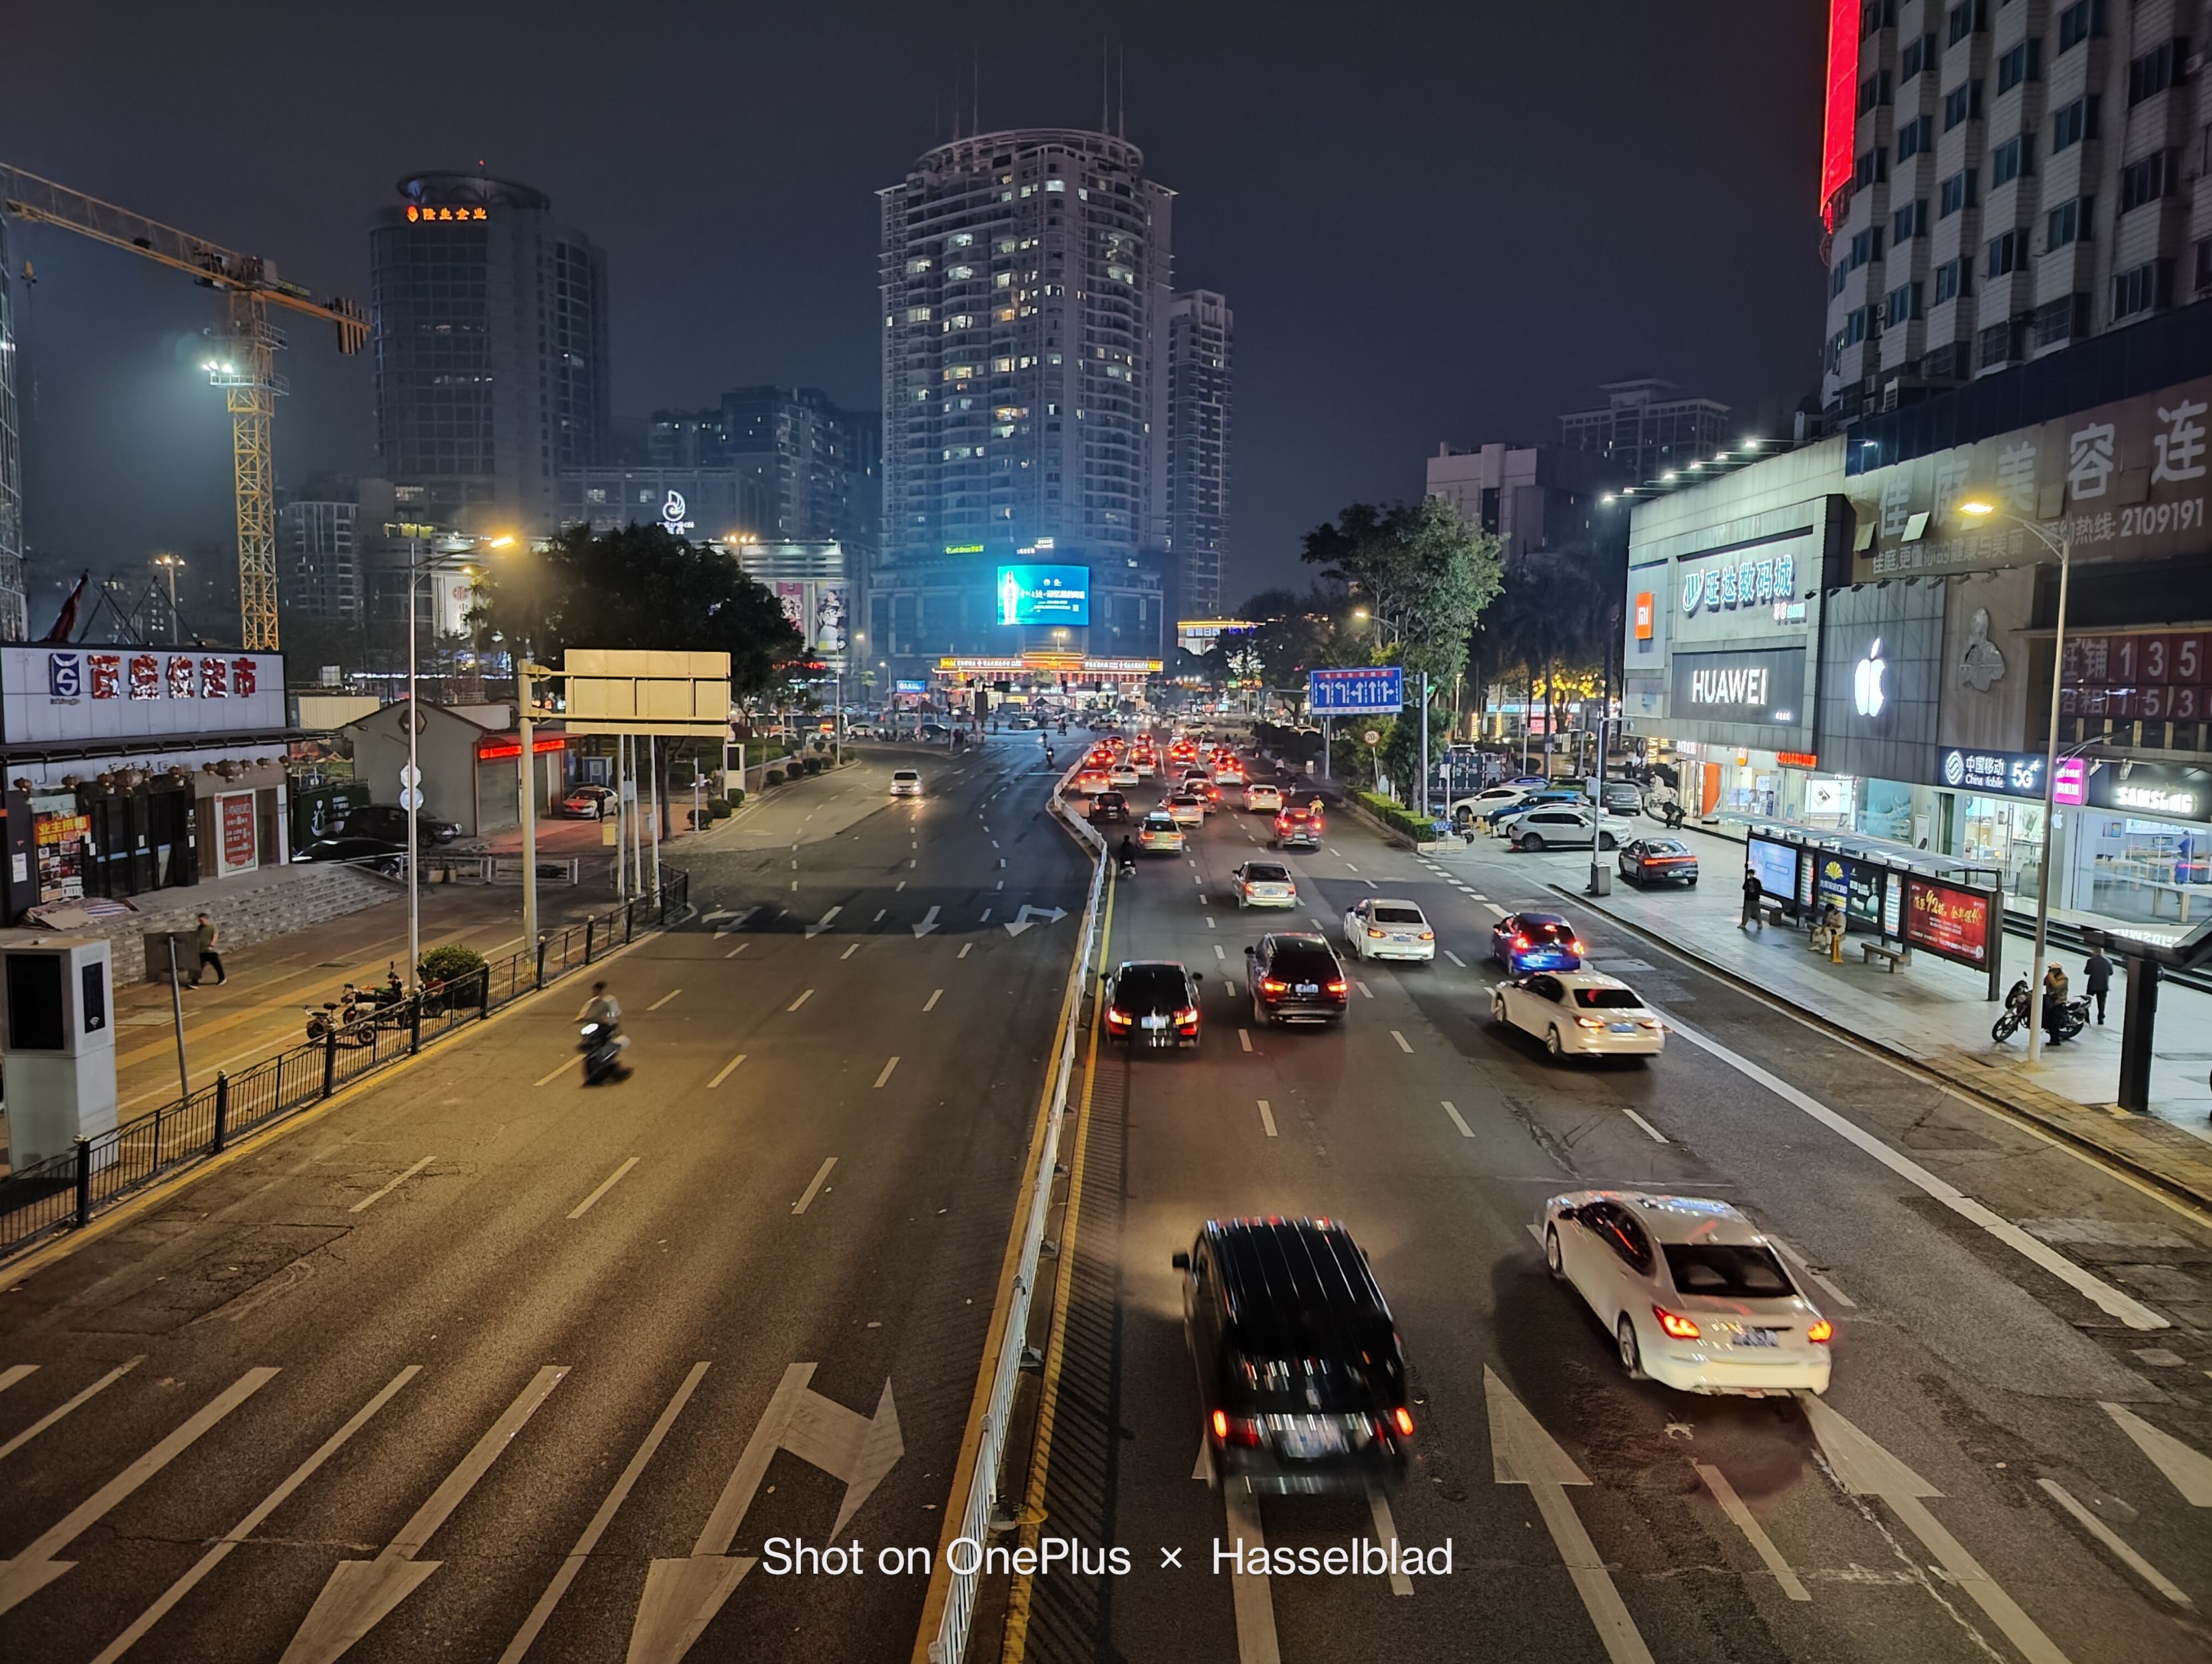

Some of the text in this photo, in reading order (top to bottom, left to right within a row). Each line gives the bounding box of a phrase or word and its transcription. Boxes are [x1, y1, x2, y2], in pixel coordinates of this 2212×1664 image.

[2119, 498, 2204, 537] 2109191
[1704, 554, 1793, 605] 旺达数码城
[1692, 667, 1769, 705] HUAWEI
[1965, 755, 2005, 776] 中国移动
[1965, 772, 1983, 786] China
